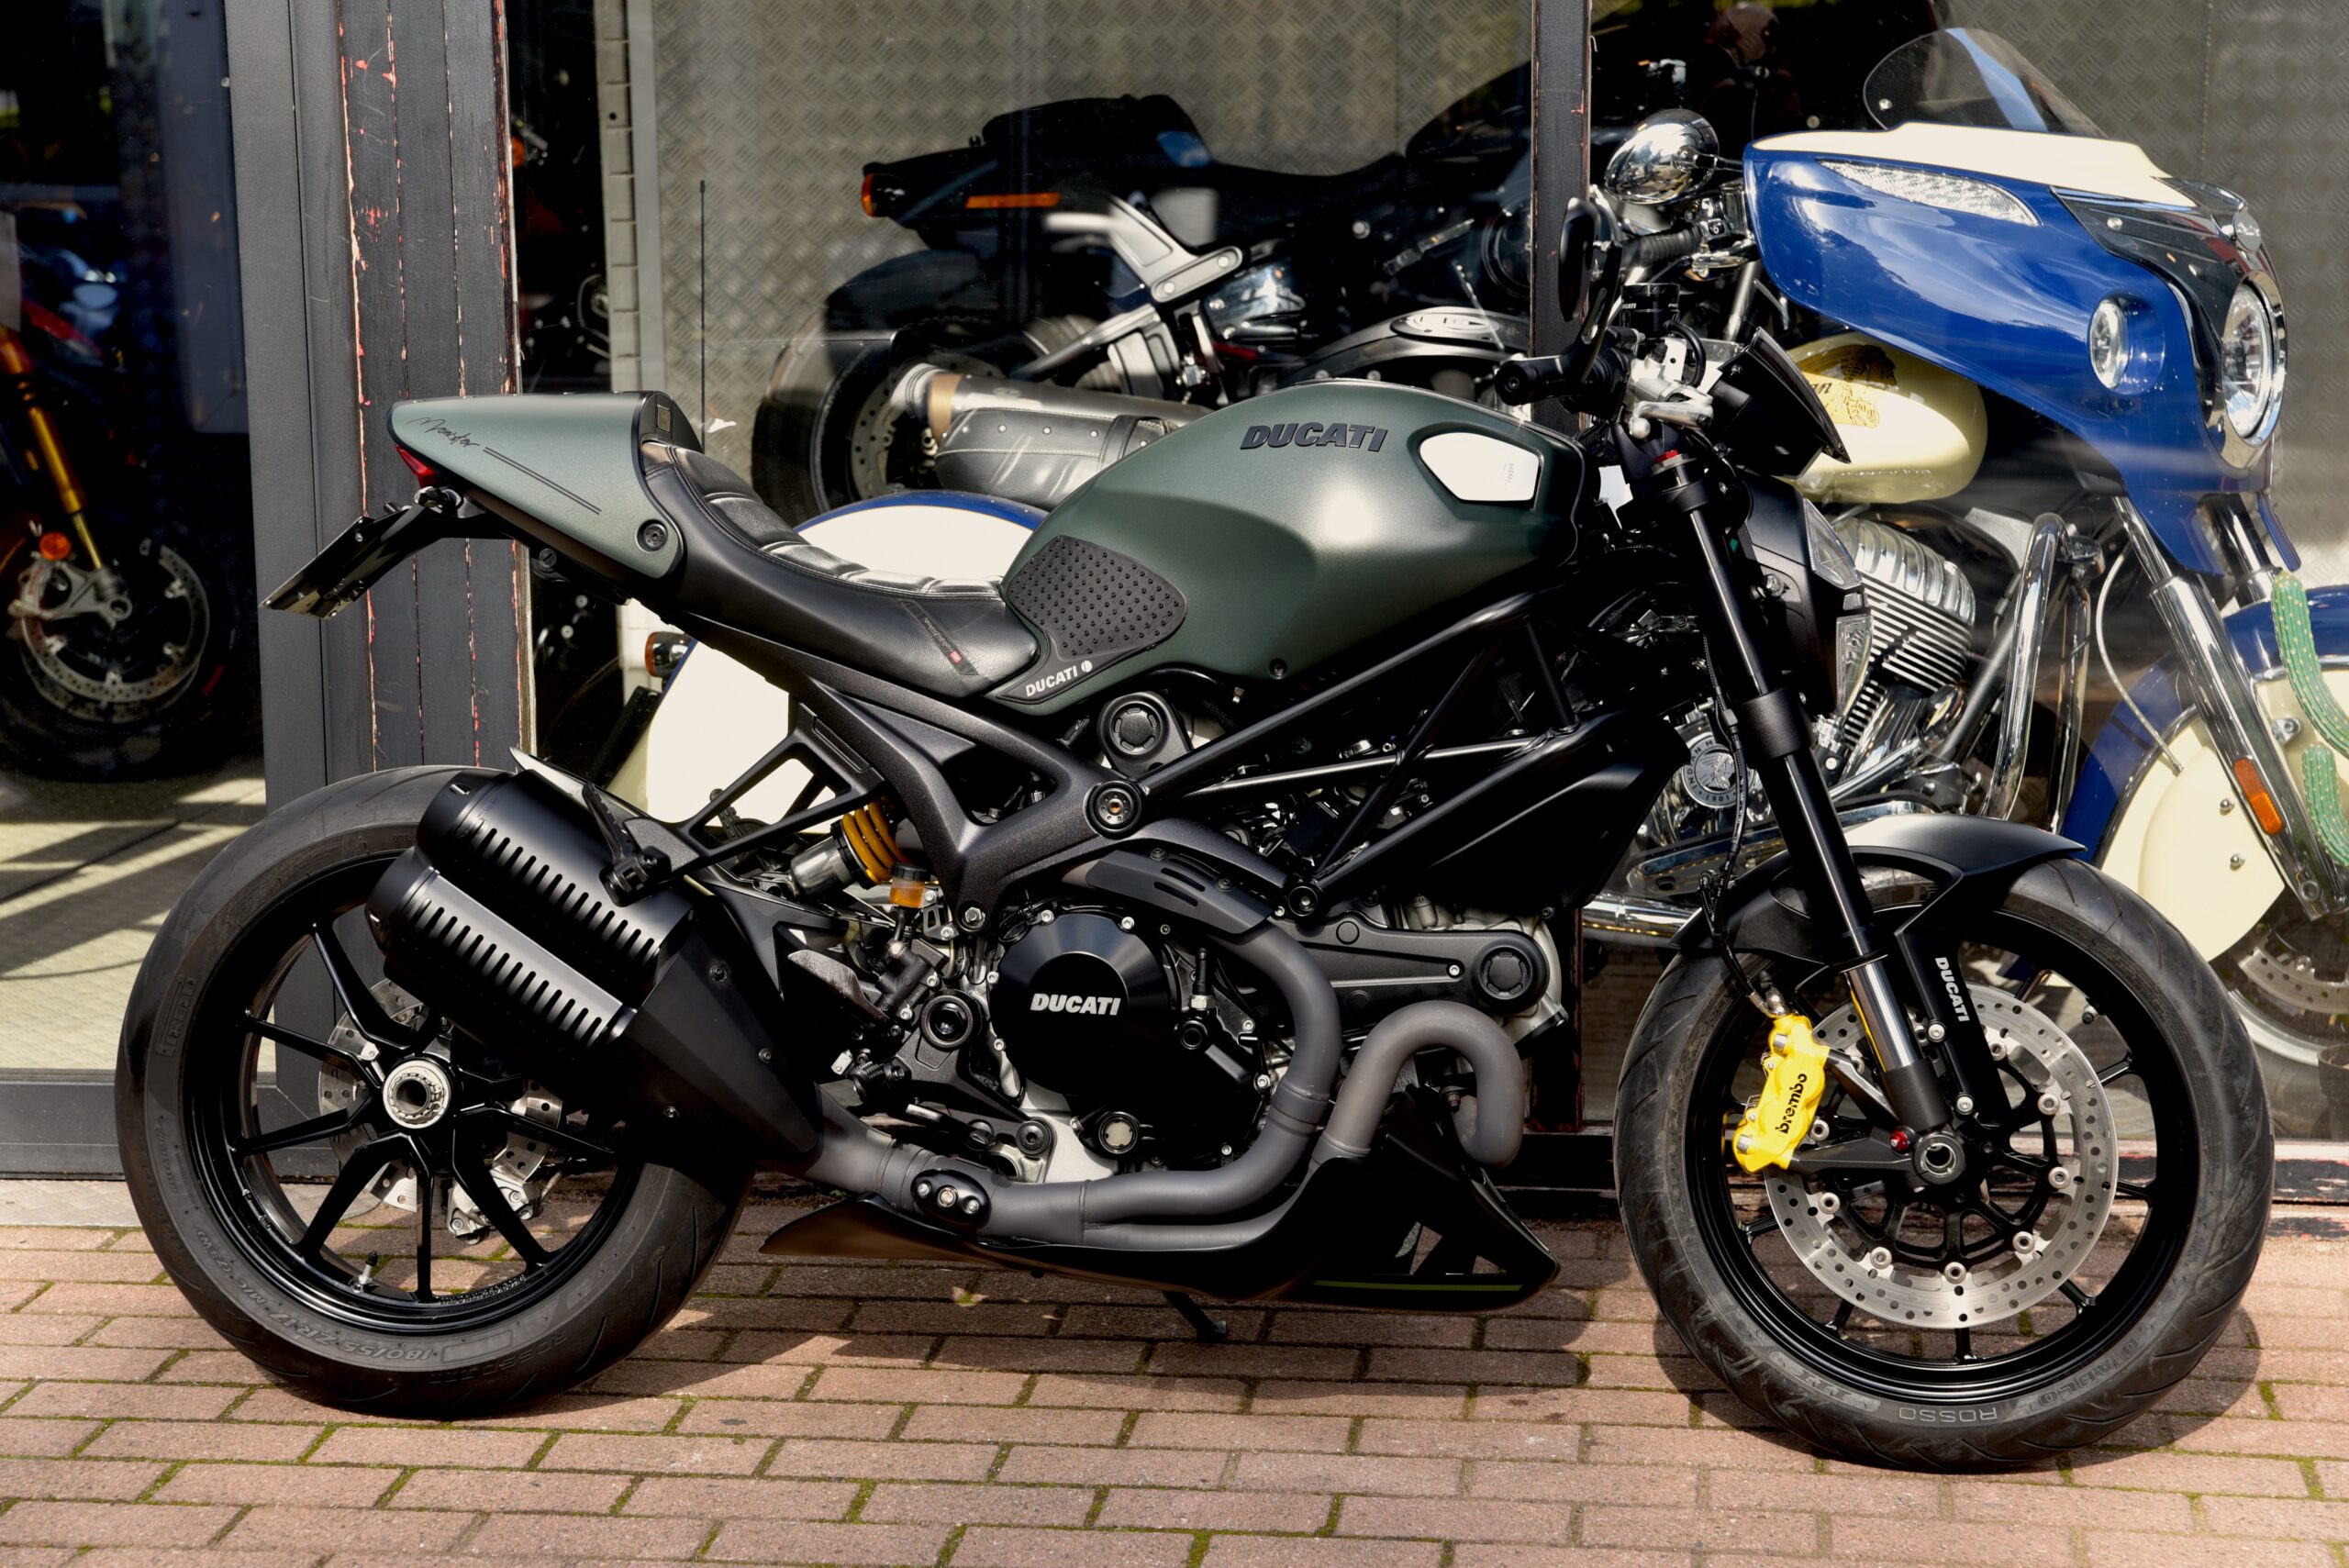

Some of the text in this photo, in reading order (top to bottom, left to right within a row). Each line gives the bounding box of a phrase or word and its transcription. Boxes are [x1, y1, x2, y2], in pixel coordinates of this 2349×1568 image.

[405, 417, 481, 448] Monster
[1240, 422, 1388, 451] DUCATI
[1025, 665, 1077, 697] DUCATI
[1030, 993, 1121, 1016] DUCATI
[1934, 957, 1970, 1022] DUCATI
[1775, 1073, 1807, 1134] brembo
[338, 1341, 434, 1361] 180/55
[2038, 1337, 2140, 1407] DIABLO
[1898, 1407, 1998, 1423] ROSSO
